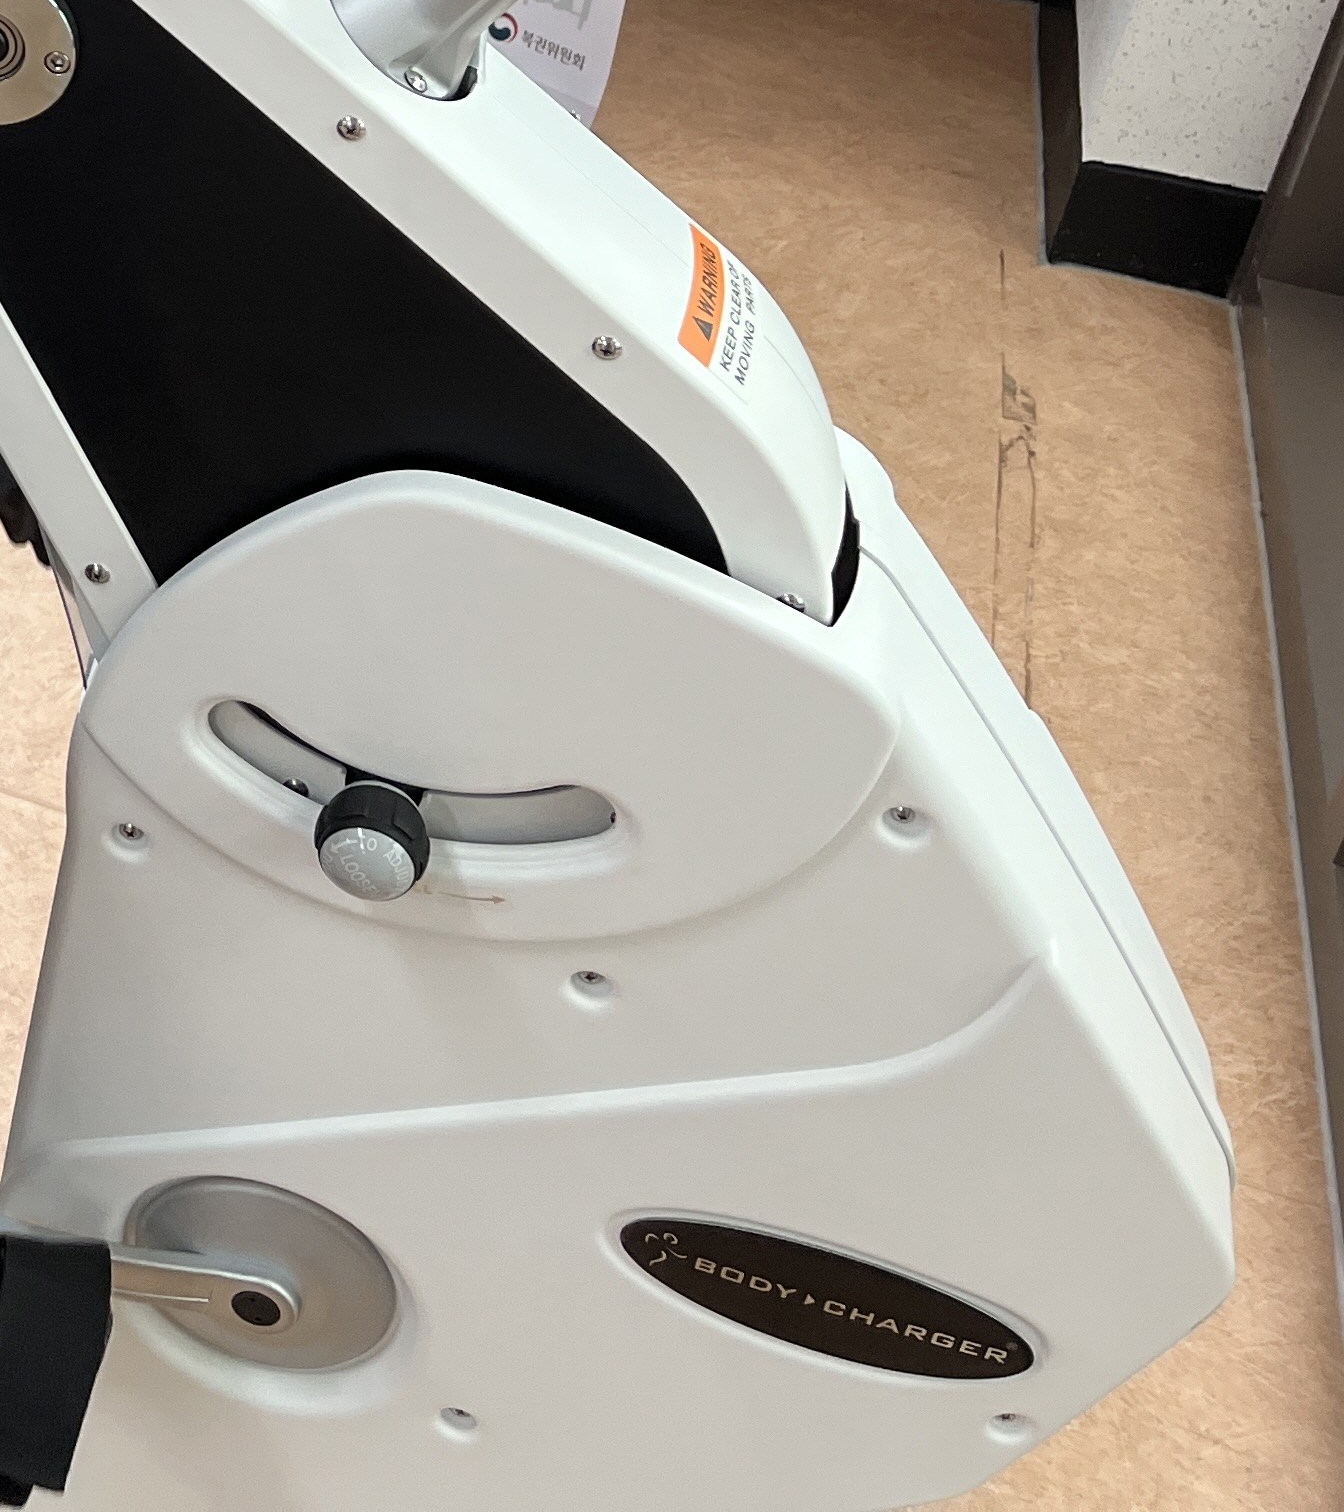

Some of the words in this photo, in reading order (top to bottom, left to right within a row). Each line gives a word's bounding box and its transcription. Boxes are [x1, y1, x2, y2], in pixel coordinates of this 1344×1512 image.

[697, 243, 717, 317] WARNING
[741, 273, 756, 316] PARTS
[719, 326, 738, 372] KEEP
[730, 279, 742, 325] CLEAR
[734, 320, 756, 385] MOVING
[694, 1257, 797, 1299] BODY
[823, 1299, 1009, 1365] CHARGER
